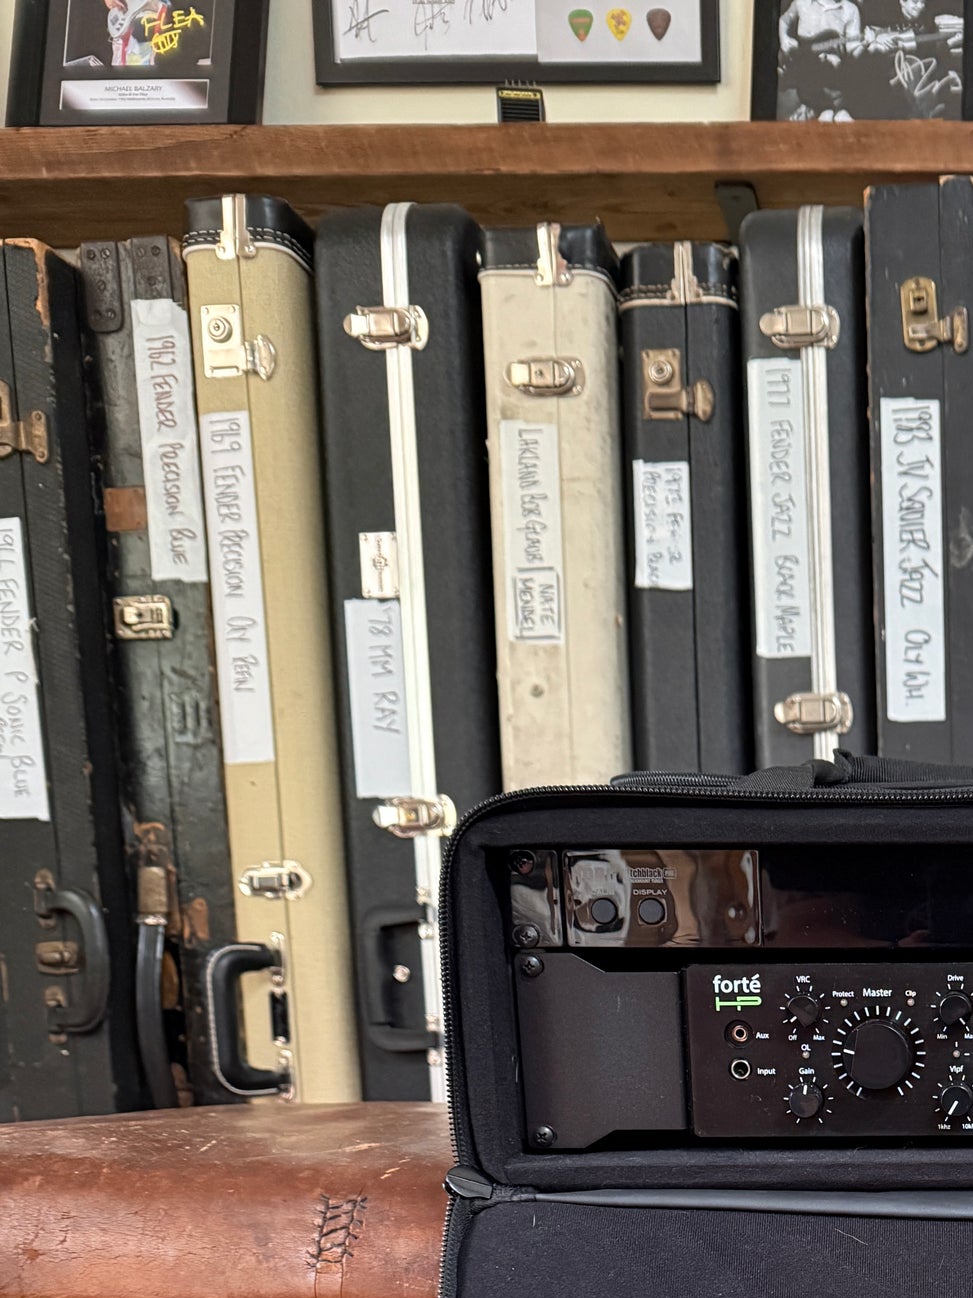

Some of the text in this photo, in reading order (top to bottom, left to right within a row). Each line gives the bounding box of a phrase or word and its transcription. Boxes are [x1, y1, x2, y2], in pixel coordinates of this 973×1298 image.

[141, 7, 204, 37] FLEA
[765, 368, 793, 408] 1977
[210, 417, 243, 454] 1969
[892, 405, 934, 445] 1983
[146, 335, 198, 565] 1962 FENDER PRECISION BLUE
[769, 419, 794, 486] FENDER
[897, 450, 934, 480] JV
[213, 465, 246, 523] FENDER
[666, 512, 685, 566] FER
[769, 492, 797, 544] JAZZ
[898, 483, 934, 554] SQUIER
[217, 529, 249, 598] PRECISION
[898, 557, 939, 607] JAZZ
[0, 578, 24, 656] FENDER
[539, 584, 555, 627] NATE
[773, 604, 801, 654] MAPLE
[4, 671, 29, 683] P
[368, 644, 394, 678] MM
[2, 692, 28, 746] SONIC
[372, 690, 402, 735] RAY
[10, 755, 36, 797] BLUE
[633, 888, 668, 896] DISPLAY
[712, 973, 762, 993] forté
[832, 990, 854, 998] Protect
[862, 988, 892, 997] Master
[905, 990, 916, 998] Clip
[757, 1068, 776, 1076] Input
